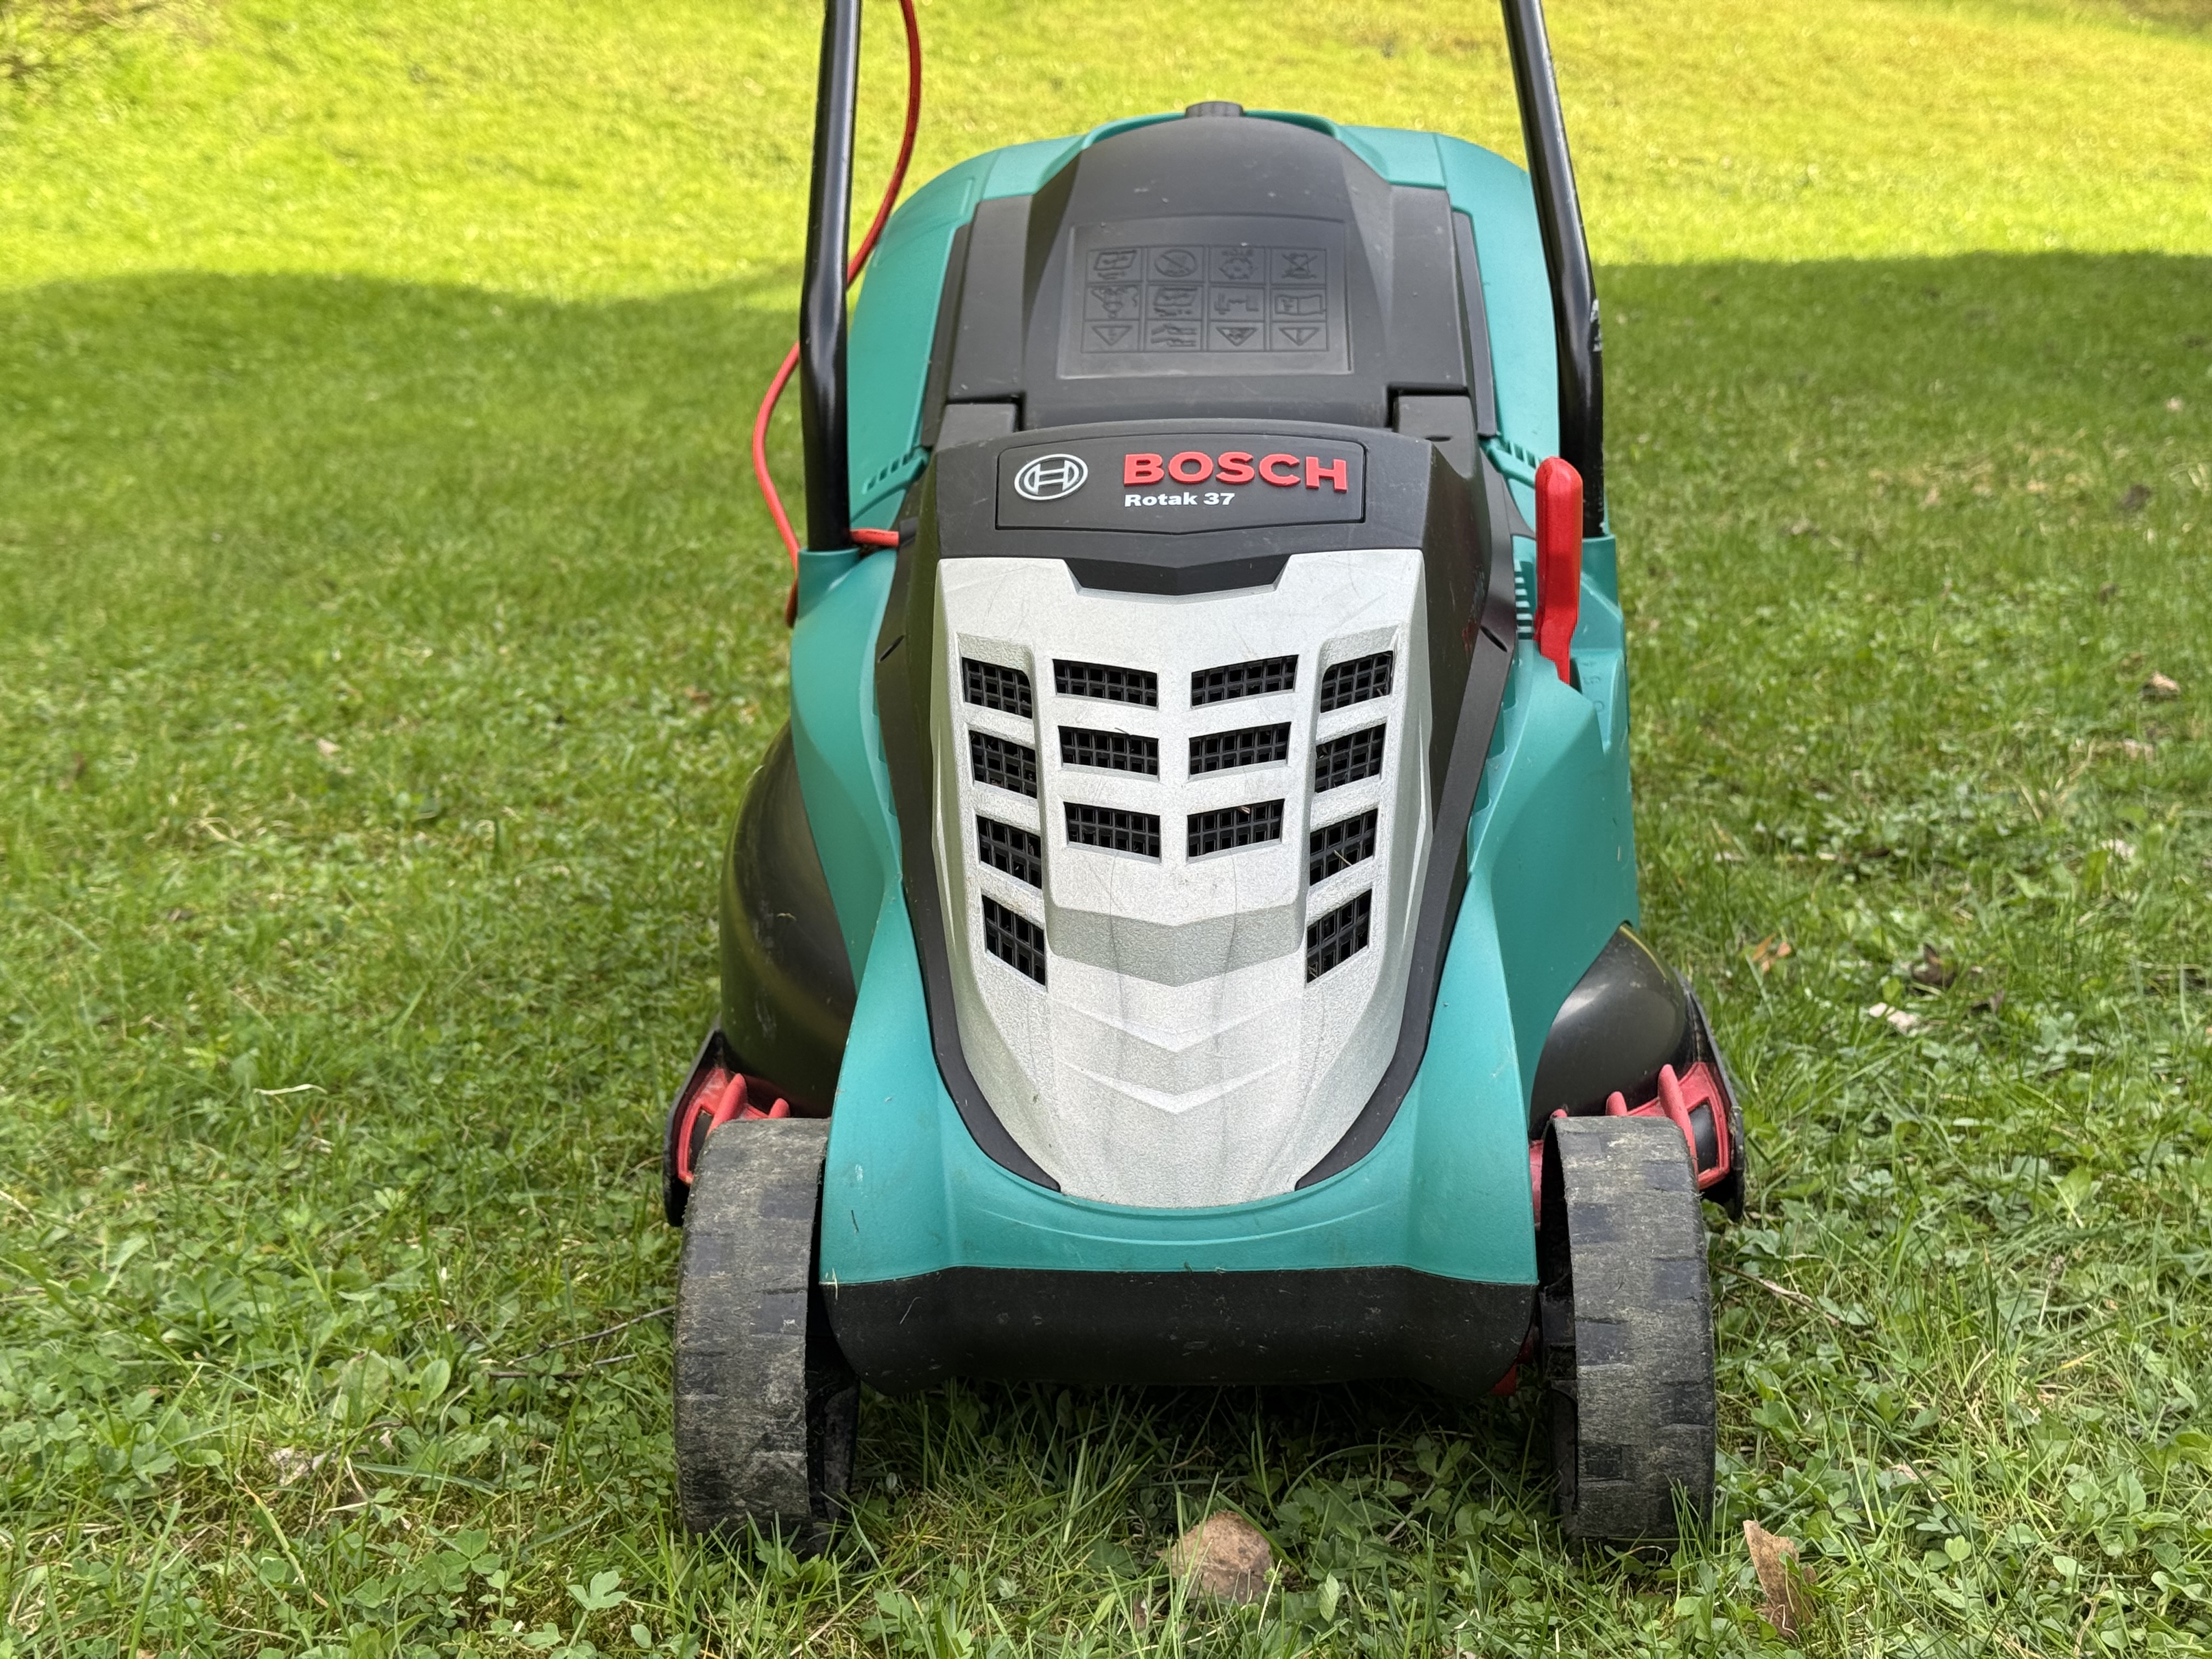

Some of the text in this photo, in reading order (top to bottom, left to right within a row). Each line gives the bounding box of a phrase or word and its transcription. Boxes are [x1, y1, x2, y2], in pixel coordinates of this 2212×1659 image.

[1123, 451, 1348, 492] BOSCH
[1124, 491, 1236, 508] Rotak 37
